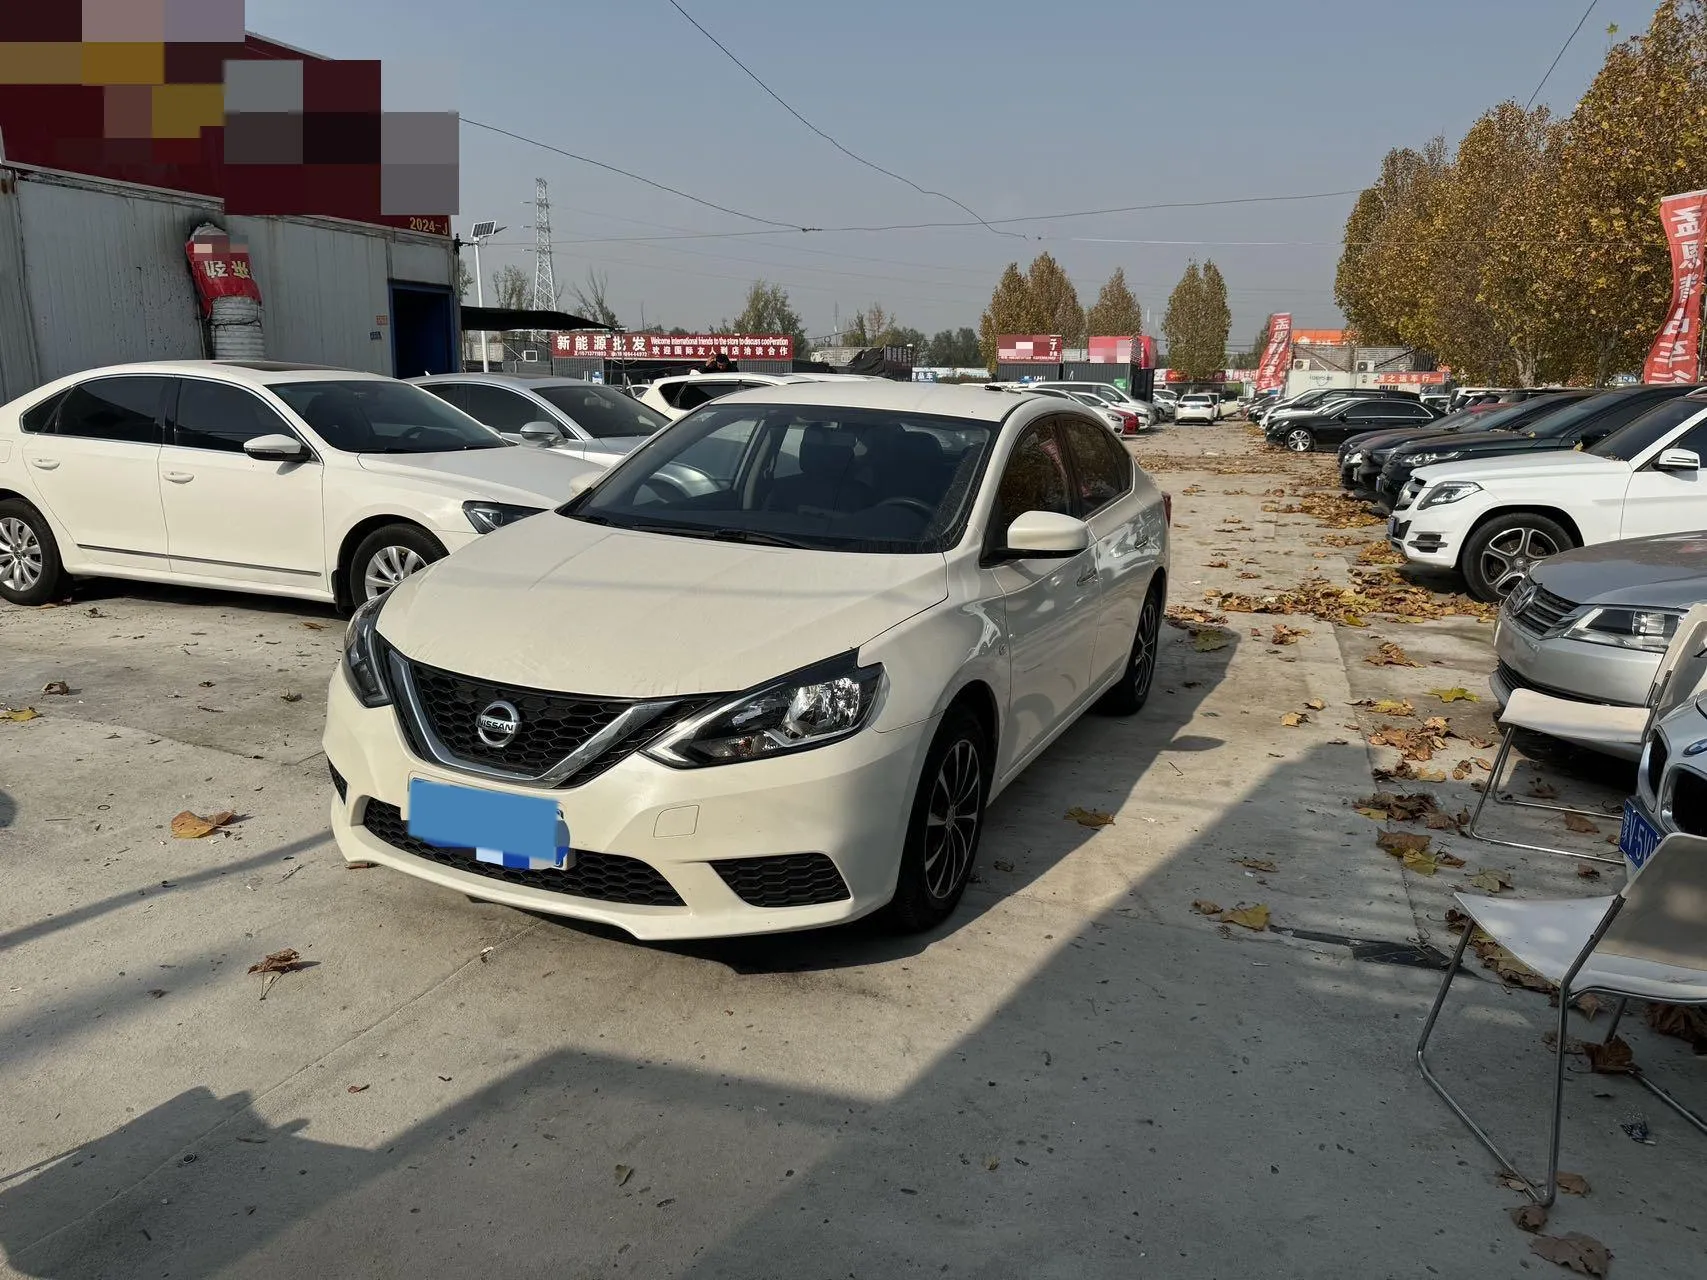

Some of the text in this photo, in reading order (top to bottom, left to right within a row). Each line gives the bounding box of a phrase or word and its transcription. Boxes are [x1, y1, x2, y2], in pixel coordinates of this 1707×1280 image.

[557, 335, 646, 351] 新能源批发
[651, 336, 670, 345] Welcome
[652, 345, 788, 356] 欢迎国际友人到店洽谈合作
[478, 719, 514, 731] NISSAN
